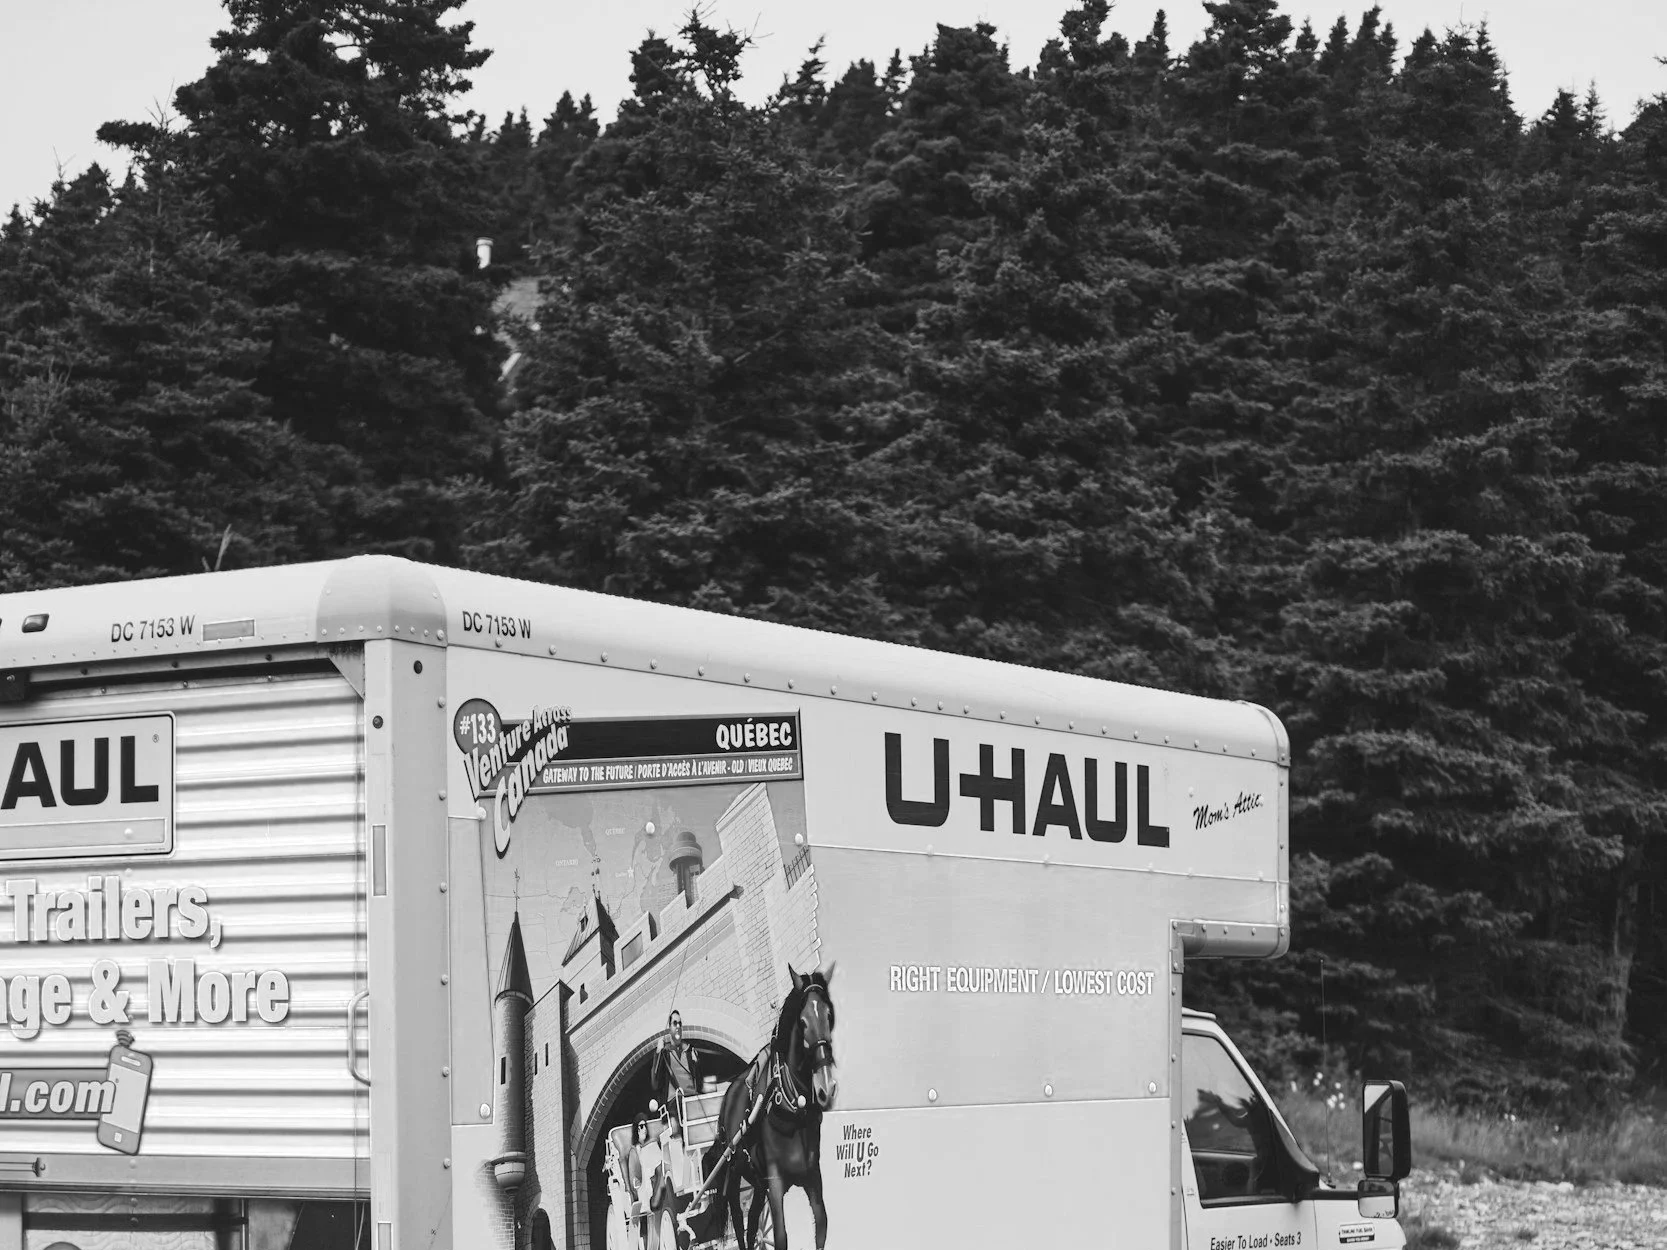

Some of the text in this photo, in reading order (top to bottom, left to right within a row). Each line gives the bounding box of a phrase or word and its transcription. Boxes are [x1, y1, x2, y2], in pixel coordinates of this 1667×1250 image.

[111, 615, 195, 642] DC 7153 W
[463, 611, 531, 639] DC 7153 W
[460, 713, 496, 744] #133
[716, 718, 793, 750] QUÉBEC
[464, 705, 572, 803] Venture Across
[543, 768, 578, 783] GATEWAY
[579, 767, 589, 782] TO
[590, 766, 605, 781] THE
[606, 764, 633, 781] FUTURE
[638, 762, 661, 779] PORTE
[698, 760, 726, 776] L'AVENIR
[731, 760, 744, 774] OLD
[748, 758, 767, 773] VIEUX
[494, 723, 569, 860] Canada
[884, 732, 1170, 848] U-HAUL
[1193, 802, 1229, 830] Mom's
[6, 875, 223, 948] Trailers,
[889, 965, 940, 992] RIGHT
[947, 967, 1038, 993] EQUIPMENT
[1054, 970, 1112, 995] LOWEST
[1116, 971, 1154, 996] COST
[0, 959, 289, 1040] ge & More
[843, 1124, 872, 1140] Where
[836, 1141, 879, 1162] Will U Go
[844, 1159, 872, 1178] Next?
[1238, 1235, 1247, 1250] To
[1249, 1234, 1268, 1249] Load
[1274, 1232, 1295, 1247] Seats
[1297, 1231, 1302, 1245] 3
